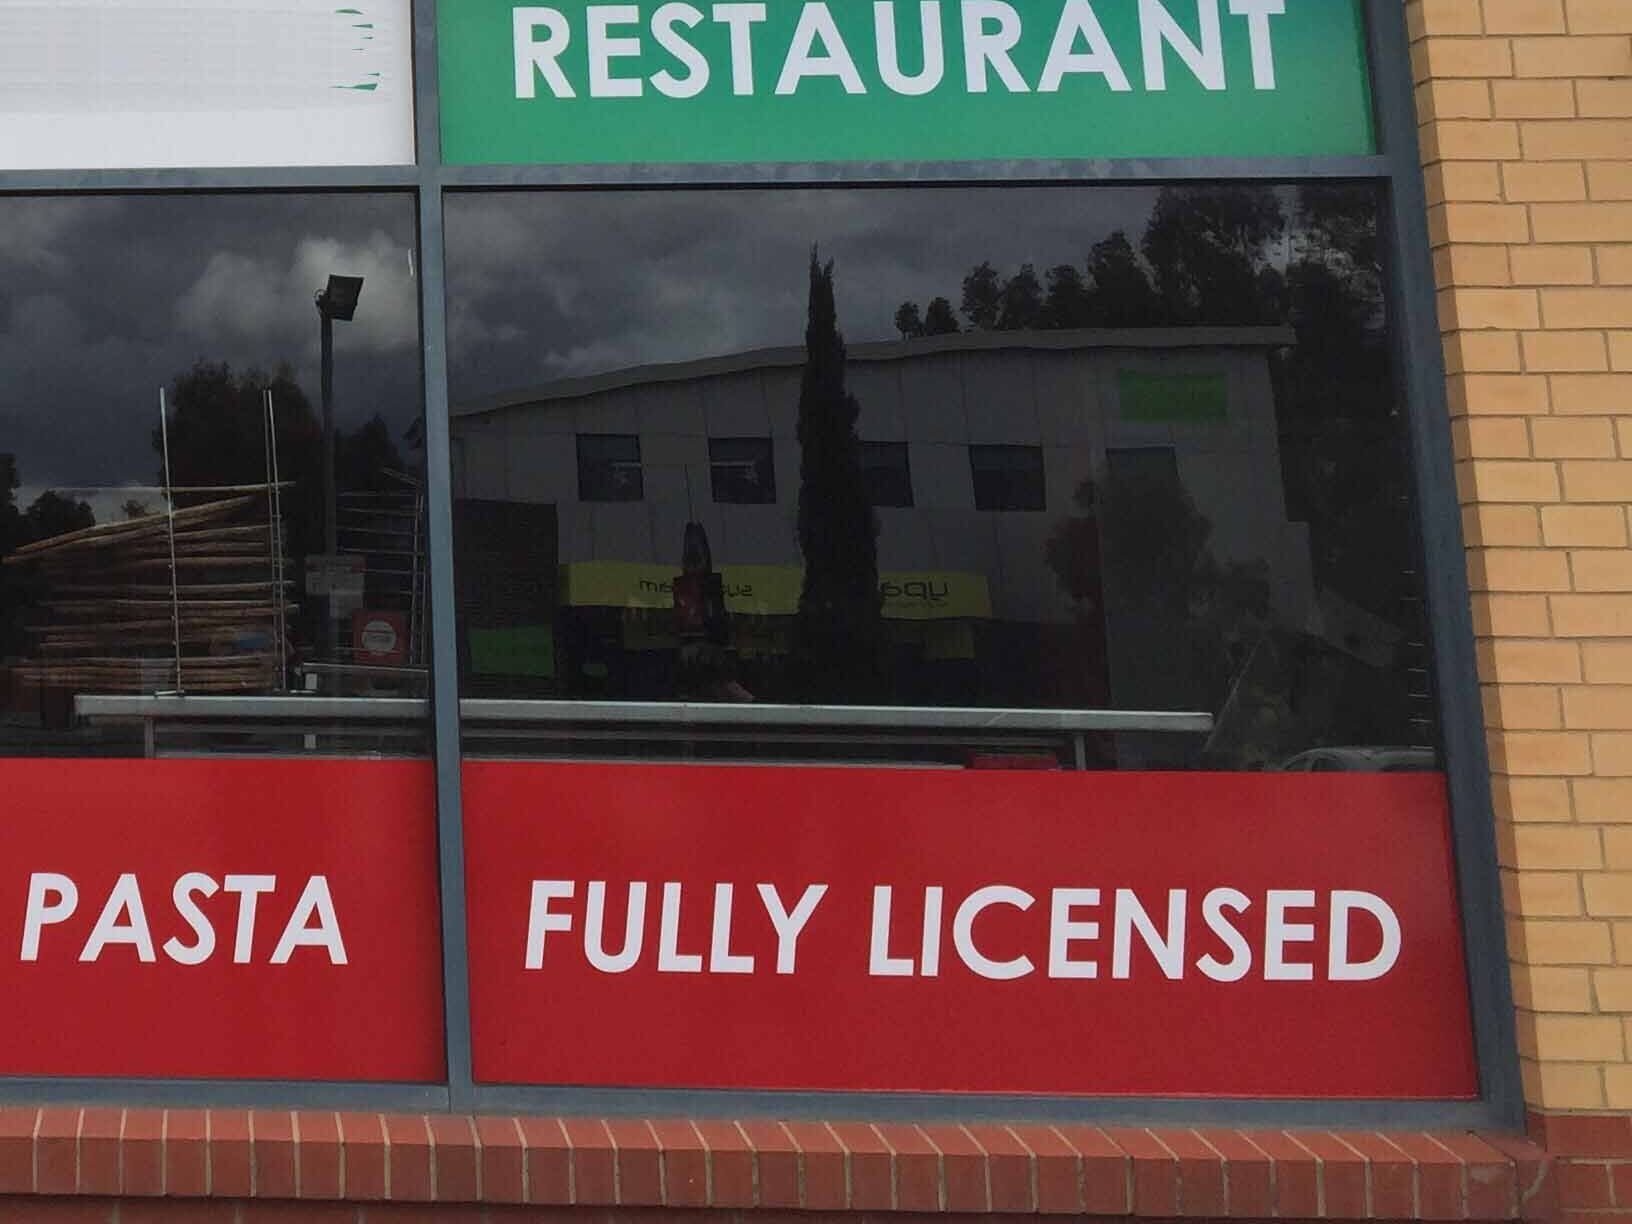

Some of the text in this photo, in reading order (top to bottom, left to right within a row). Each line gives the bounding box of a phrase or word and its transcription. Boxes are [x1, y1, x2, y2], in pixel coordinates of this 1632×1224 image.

[20, 872, 348, 965] PASTA
[526, 879, 1401, 983] FULLY LICENSED
